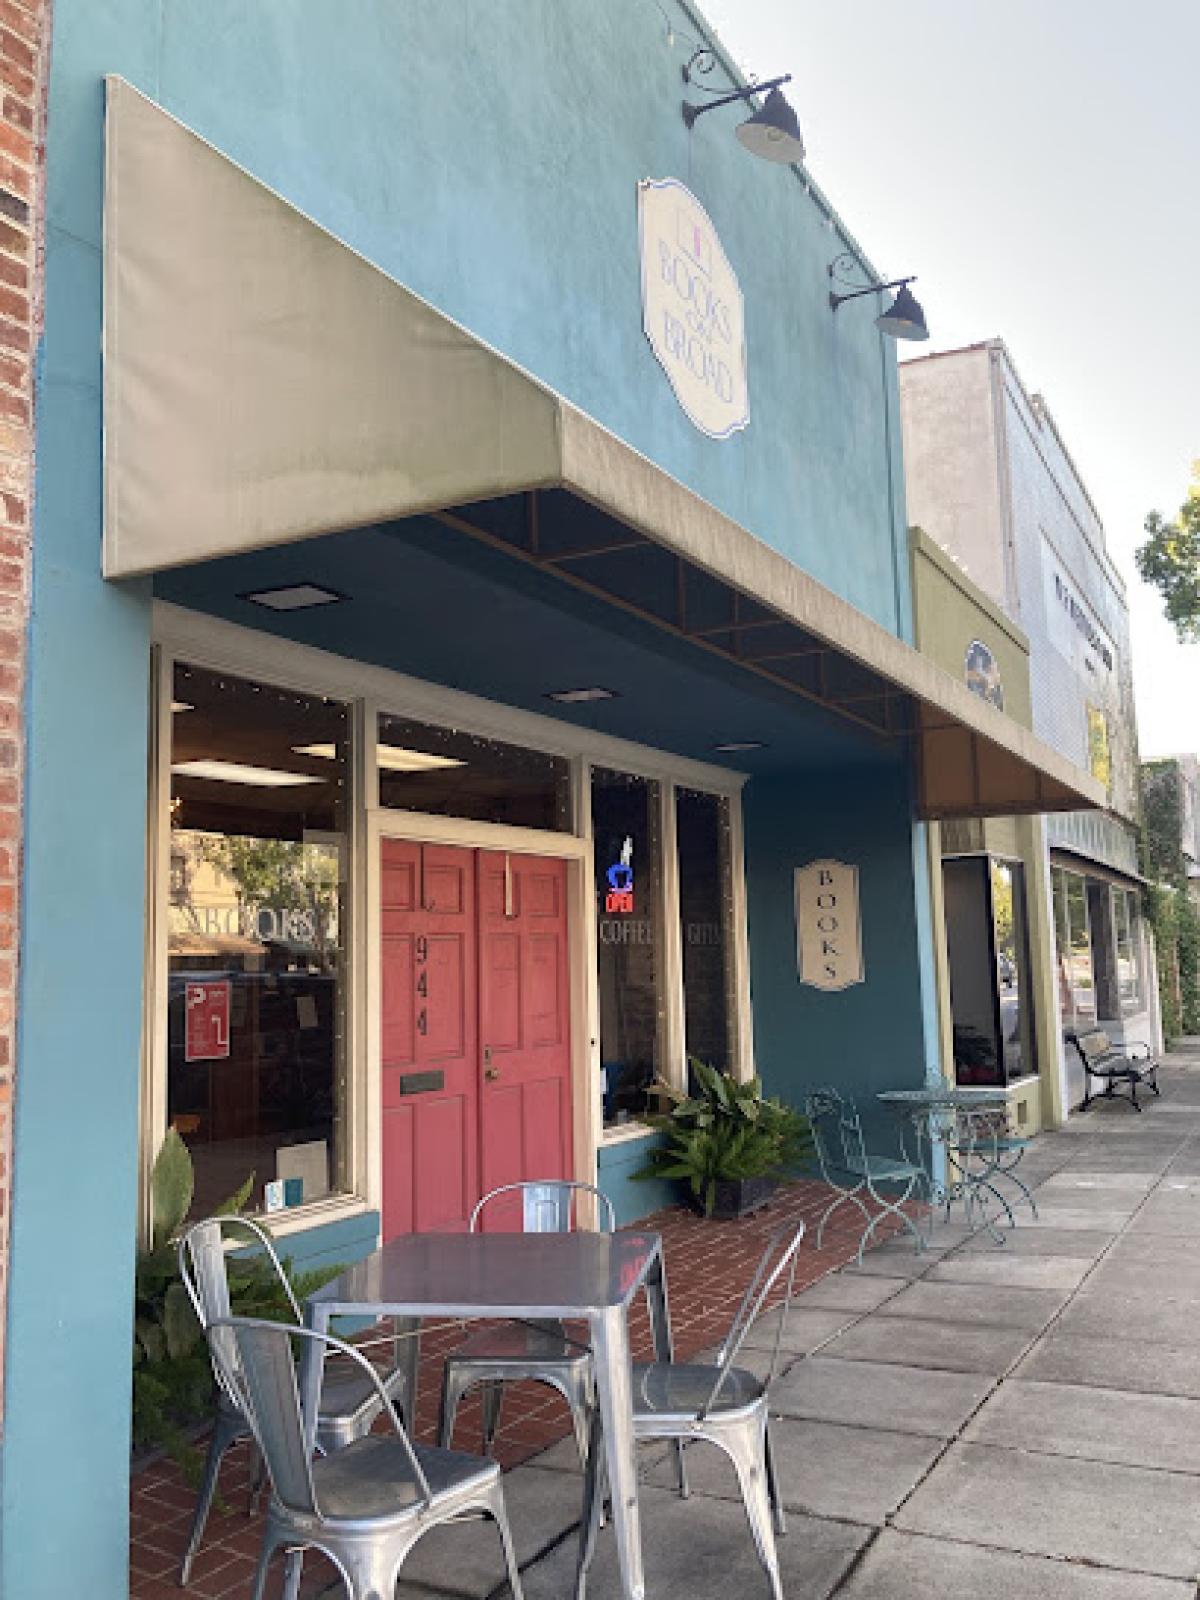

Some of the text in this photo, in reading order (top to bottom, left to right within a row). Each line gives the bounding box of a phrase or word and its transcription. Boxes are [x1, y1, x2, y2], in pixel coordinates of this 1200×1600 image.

[659, 239, 732, 345] BOOKS
[600, 919, 653, 944] COFFEE
[606, 893, 634, 912] OPEN
[817, 870, 838, 978] BOOKS
[416, 934, 428, 1036] 944
